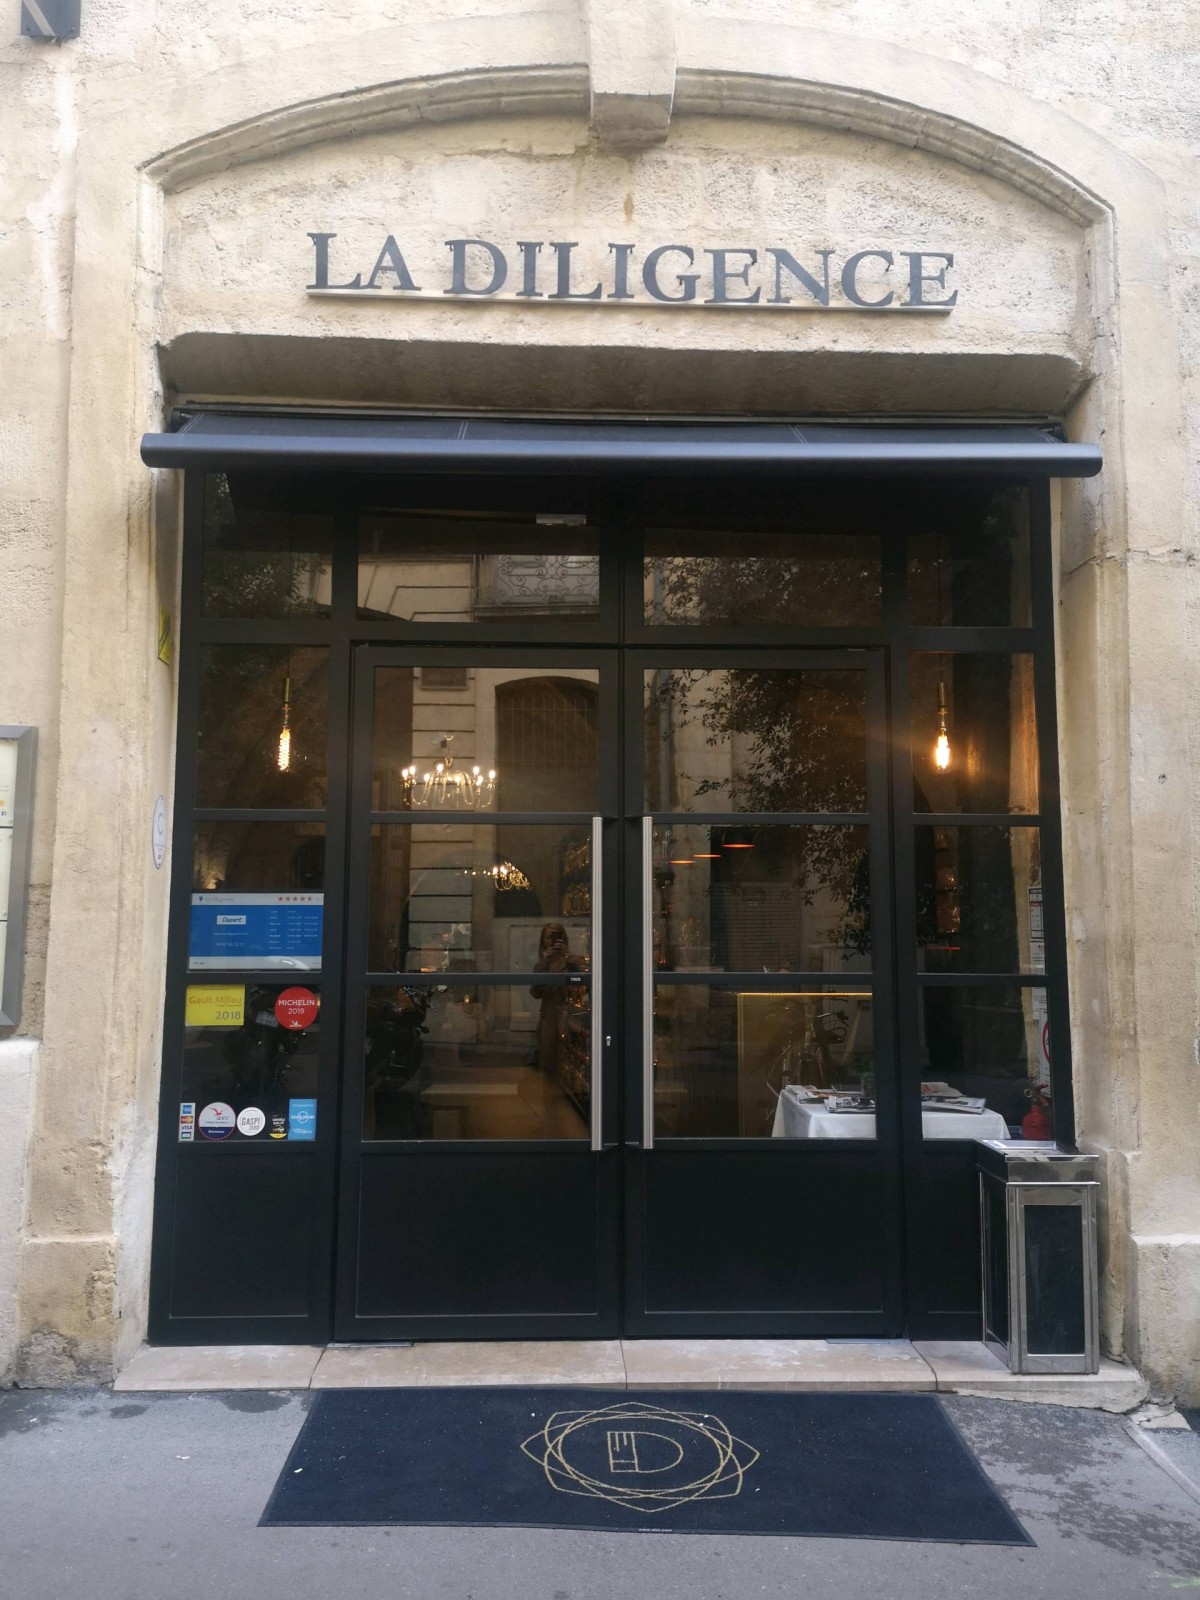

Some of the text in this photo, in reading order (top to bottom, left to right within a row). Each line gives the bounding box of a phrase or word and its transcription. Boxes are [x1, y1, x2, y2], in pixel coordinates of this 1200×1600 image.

[306, 232, 959, 307] LA DILIGENCE
[221, 916, 243, 924] Ouvert
[278, 999, 315, 1007] MICHELIN
[287, 1007, 305, 1015] 2019
[215, 1011, 241, 1020] 2018
[241, 1117, 261, 1126] GASPI
